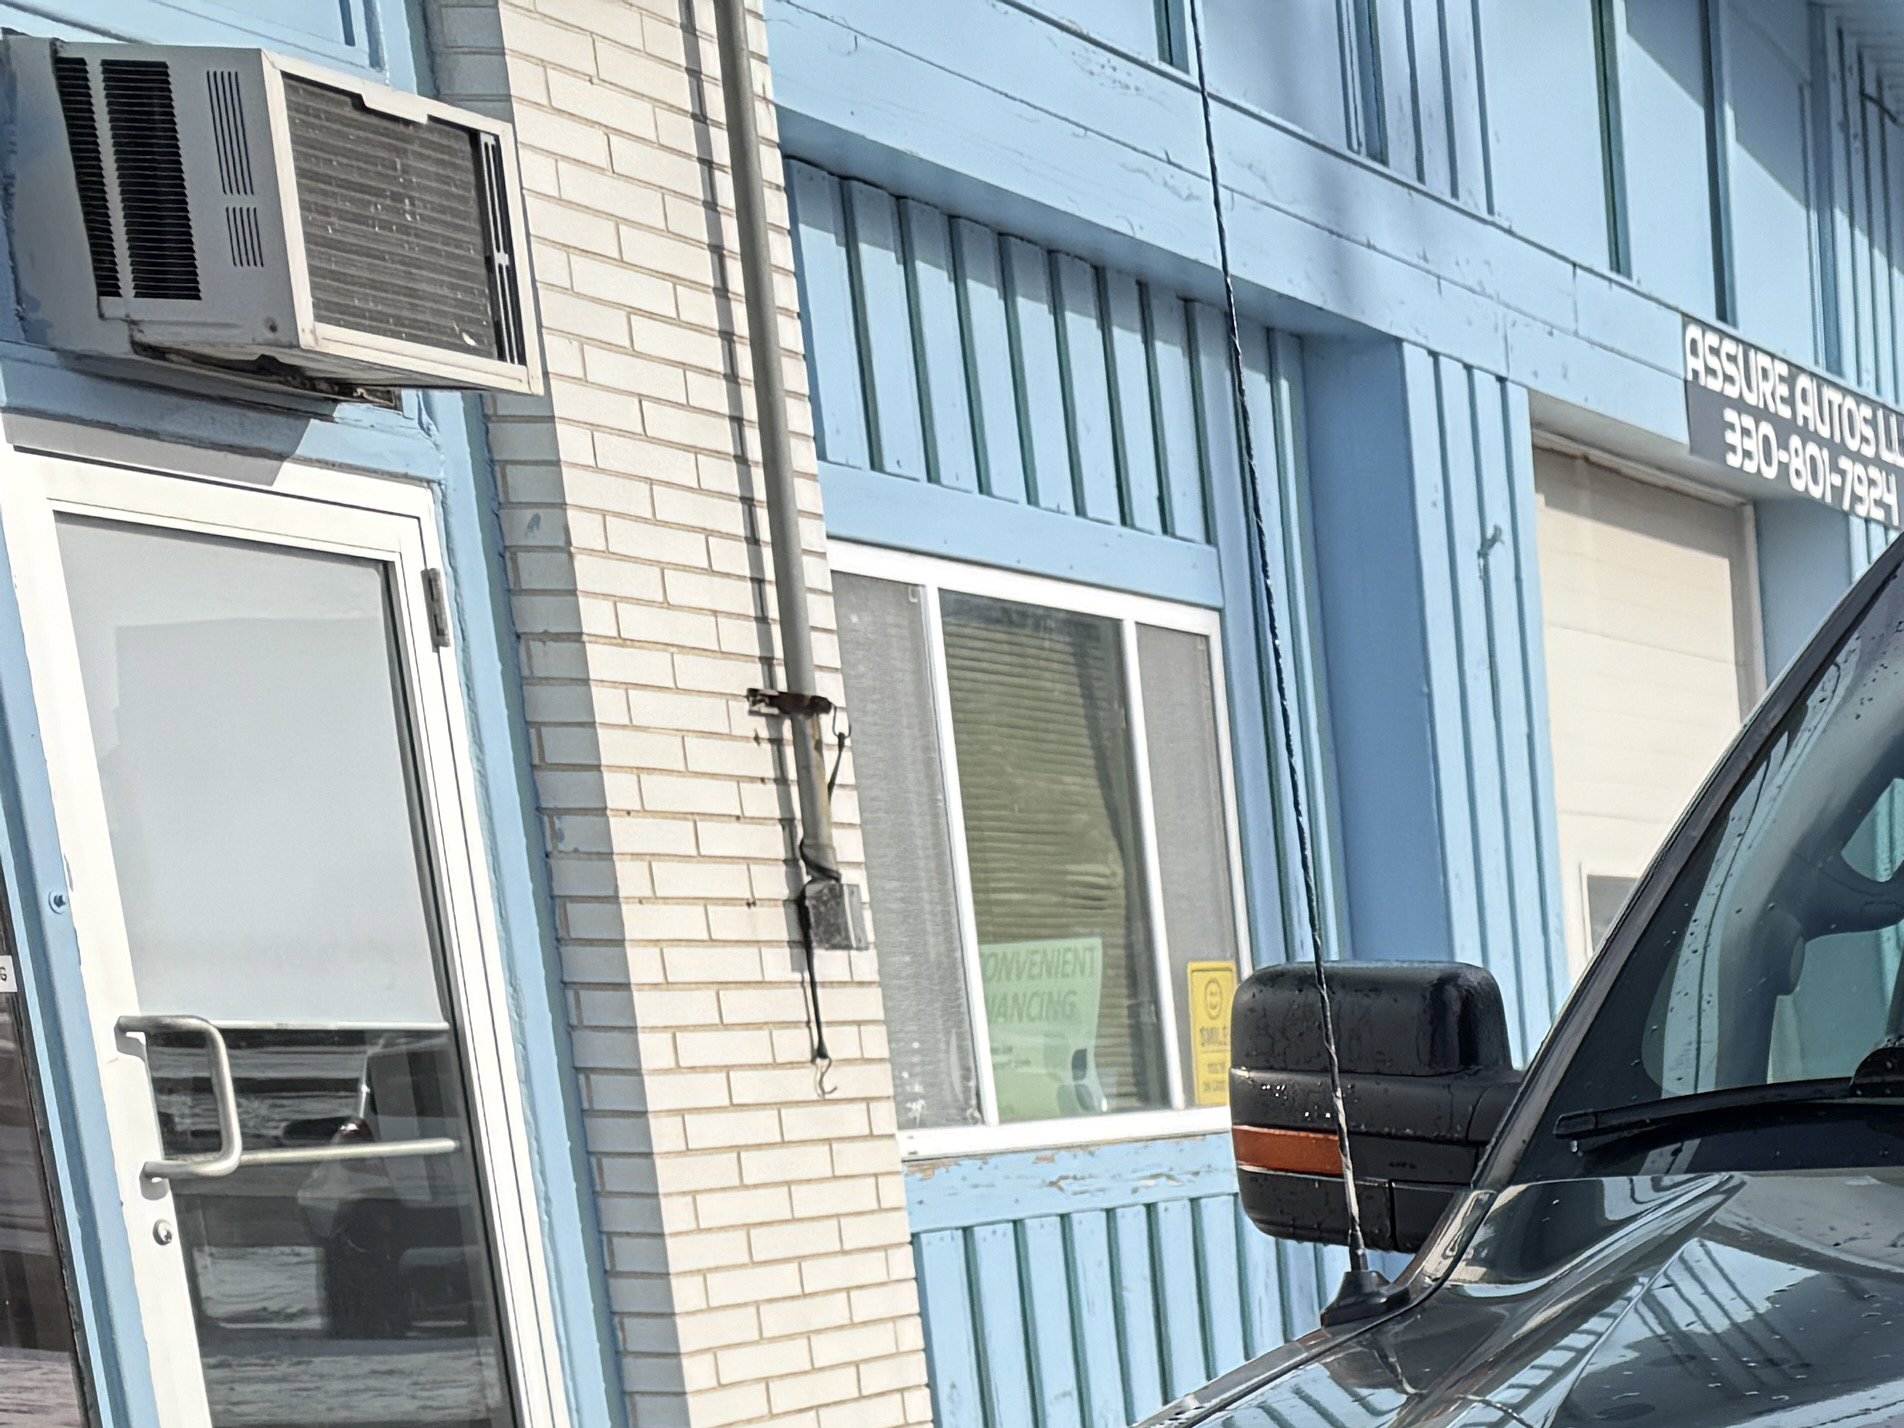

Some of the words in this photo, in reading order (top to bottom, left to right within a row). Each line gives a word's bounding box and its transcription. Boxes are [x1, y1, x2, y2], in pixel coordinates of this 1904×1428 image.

[1685, 324, 1792, 420] ASSURE
[1795, 373, 1875, 458] AUTOS
[1723, 408, 1900, 527] 330-801-7924
[981, 945, 1097, 983] ONVENIENT
